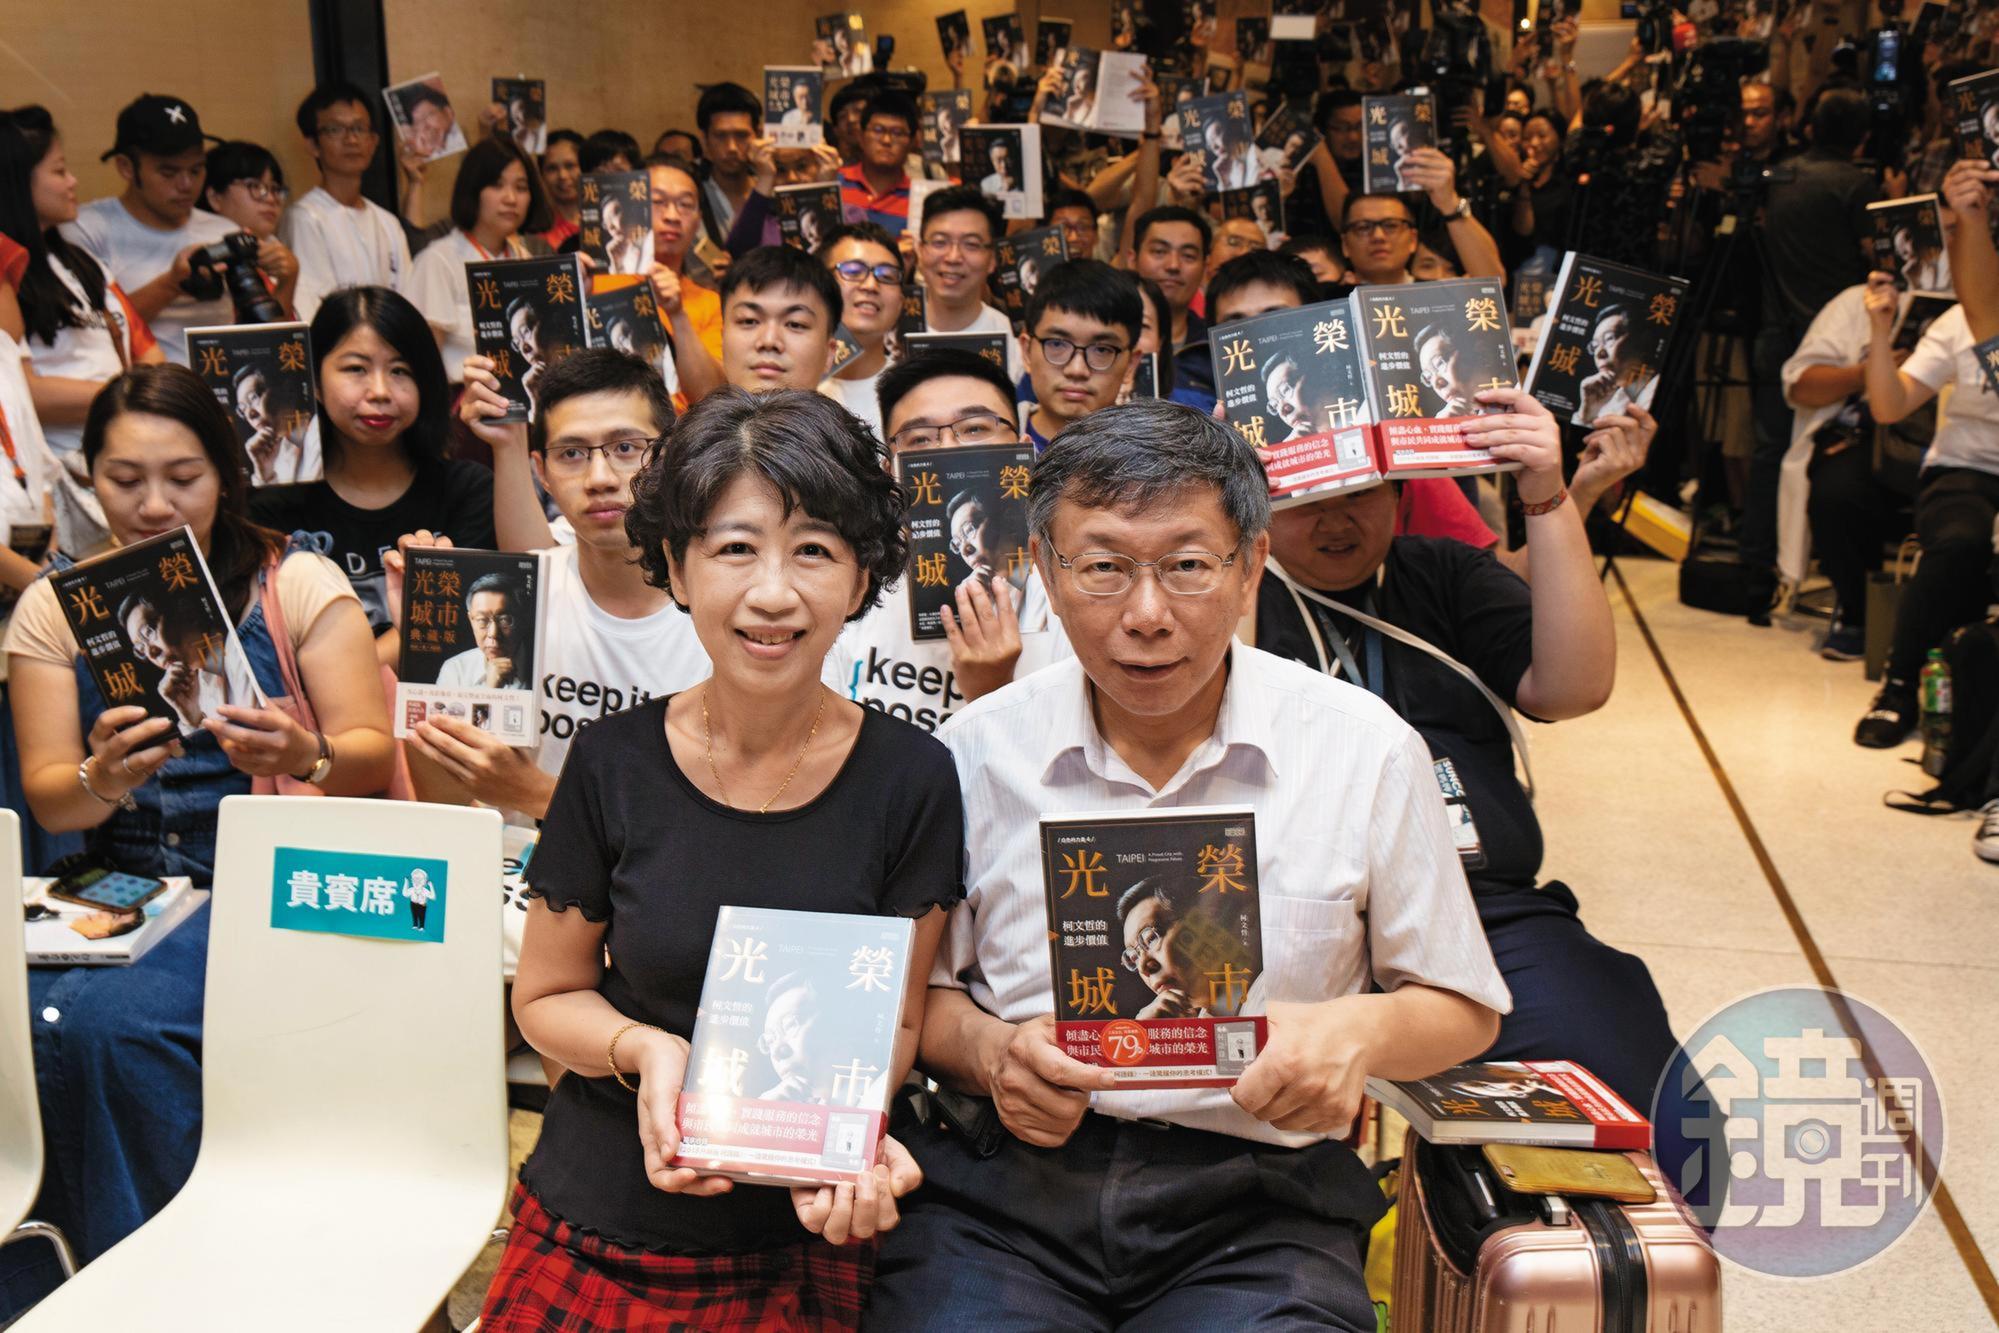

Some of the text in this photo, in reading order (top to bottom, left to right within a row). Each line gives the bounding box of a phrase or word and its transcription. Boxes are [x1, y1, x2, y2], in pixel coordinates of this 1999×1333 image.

[476, 273, 575, 310] 光 榮
[1570, 275, 1677, 326] 光 榮
[1372, 297, 1501, 339] 光 榮
[200, 341, 306, 377] 光 榮
[1222, 318, 1349, 377] 光 榮
[1548, 343, 1581, 376] 城
[1324, 398, 1359, 429] 市
[1386, 383, 1423, 418] 城
[910, 465, 1030, 507] 光 榮
[70, 552, 198, 625] 光 榮
[413, 571, 463, 598] 光榮
[916, 552, 949, 588] 城
[410, 600, 460, 627] 城市
[103, 662, 145, 699] 城
[866, 647, 963, 708] keep
[1058, 844, 1247, 899] 光 榮
[1116, 853, 1145, 863] TAIPEI
[286, 870, 398, 916] 貴賓席
[1062, 919, 1107, 932] 柯文哲的
[1063, 933, 1108, 947] 進步價值
[719, 937, 895, 992] 光 榮
[1067, 962, 1252, 1015] 城 市
[831, 1057, 879, 1106] 市
